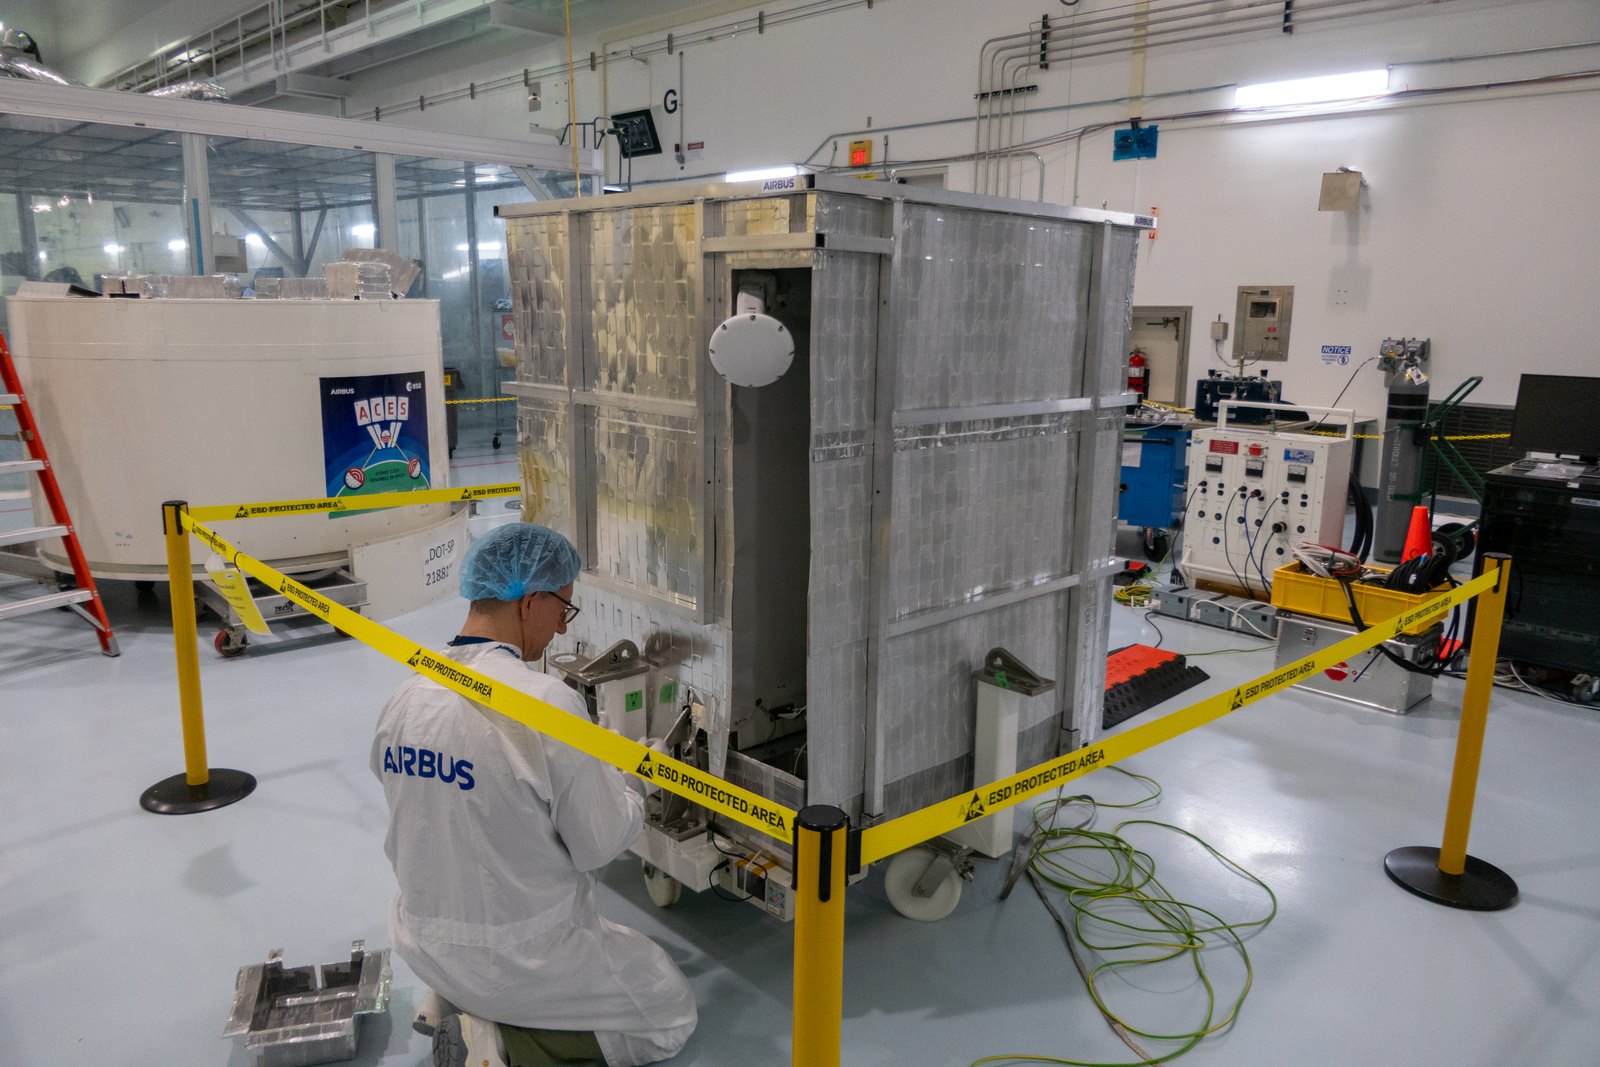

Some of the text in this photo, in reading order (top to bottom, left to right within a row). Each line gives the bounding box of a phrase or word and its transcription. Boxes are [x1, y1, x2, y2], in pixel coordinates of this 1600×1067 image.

[664, 89, 678, 114] G
[763, 179, 795, 190] AIRBUS
[359, 402, 407, 420] ACES
[487, 486, 520, 494] PROTECTE
[269, 503, 315, 512] PROTECTED
[317, 501, 338, 509] AREA
[287, 583, 330, 615] ESD PROTECTED AREA
[421, 655, 493, 698] ESD PROTECTED AREA
[1245, 660, 1316, 699] ESD PROTECTED AREA
[384, 746, 475, 791] AIRBUS
[988, 749, 1105, 806] ESD PROTECTED AREA
[658, 763, 786, 831] ESD PROTECTED AREA
